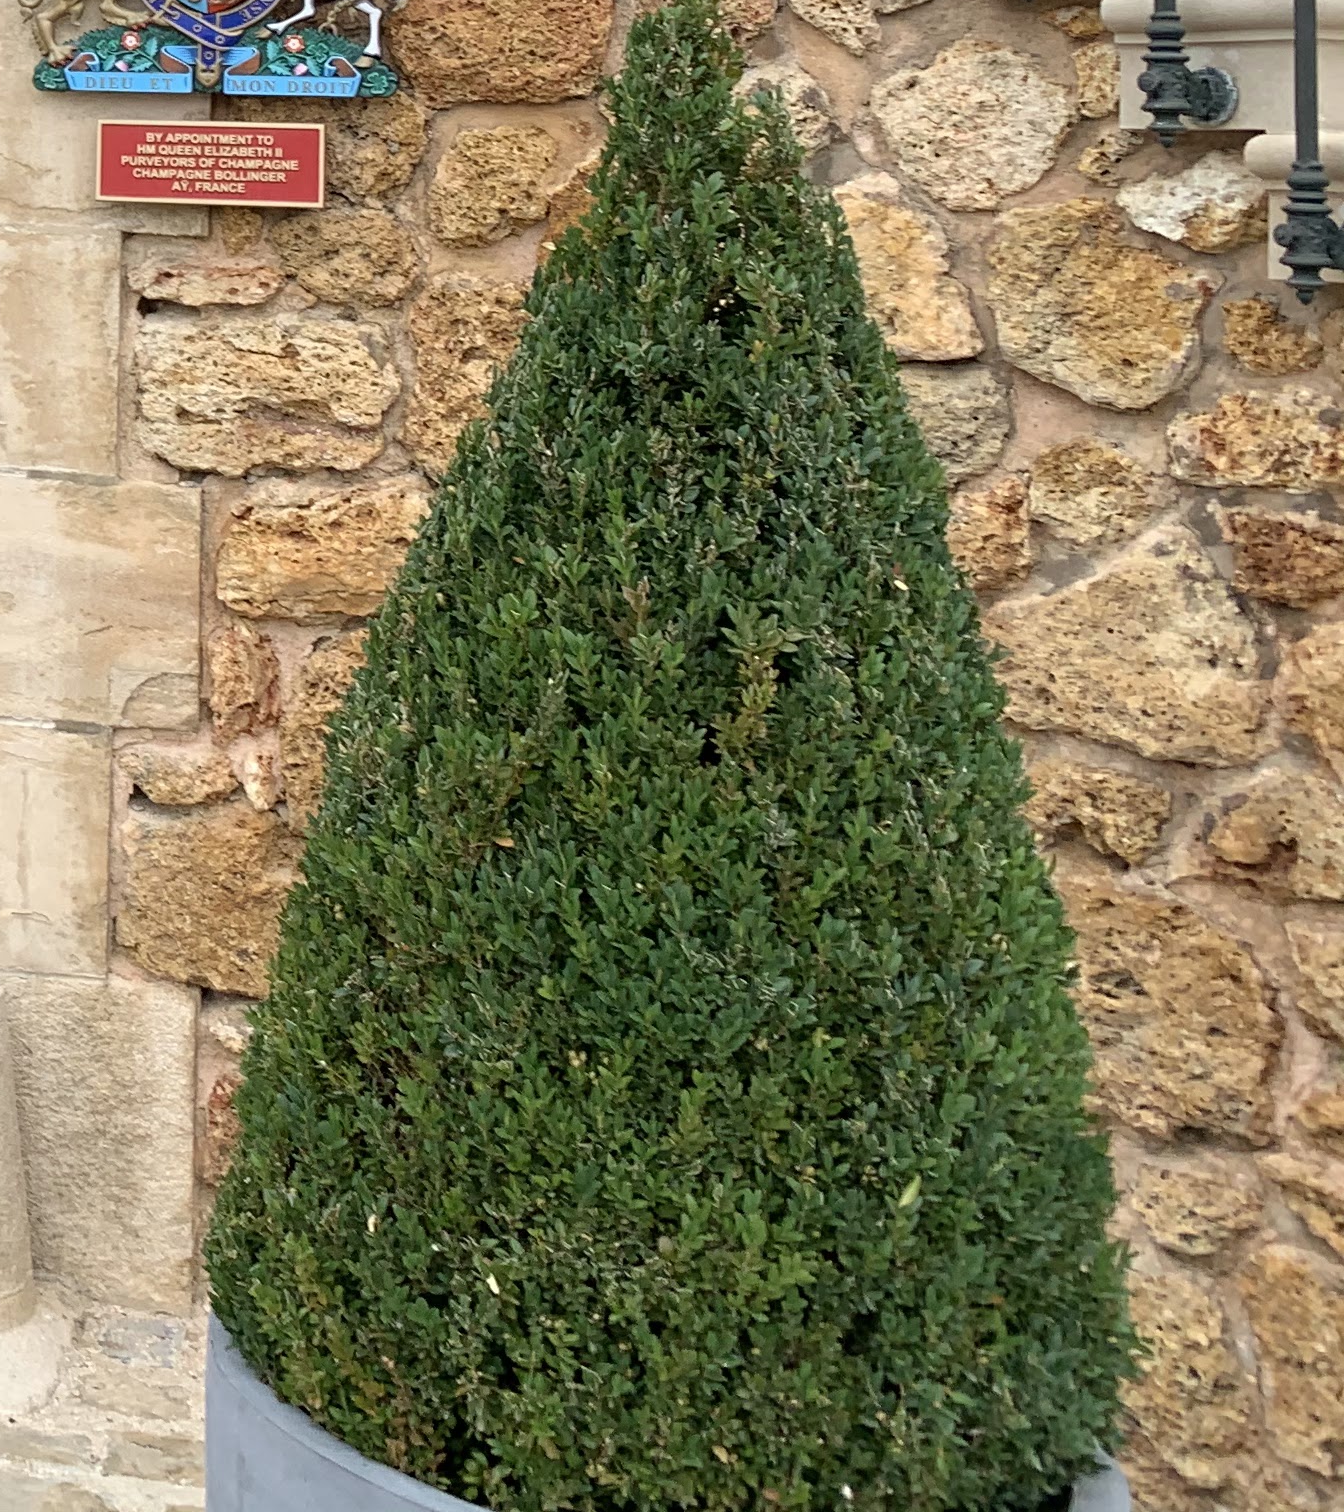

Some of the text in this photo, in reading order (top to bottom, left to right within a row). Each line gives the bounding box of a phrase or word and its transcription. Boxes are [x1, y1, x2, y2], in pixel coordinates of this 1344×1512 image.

[85, 76, 350, 94] DIEU ET MON DROIT
[145, 132, 274, 145] BY APPOINTMENT TO
[137, 144, 283, 158] HM QUEEN ELIZABETH II
[121, 155, 299, 171] PURVEYORS OF CHAMPAGNE
[132, 168, 286, 182] CHAMPAGNE BOLLINGER
[195, 182, 246, 194] FRANCE
